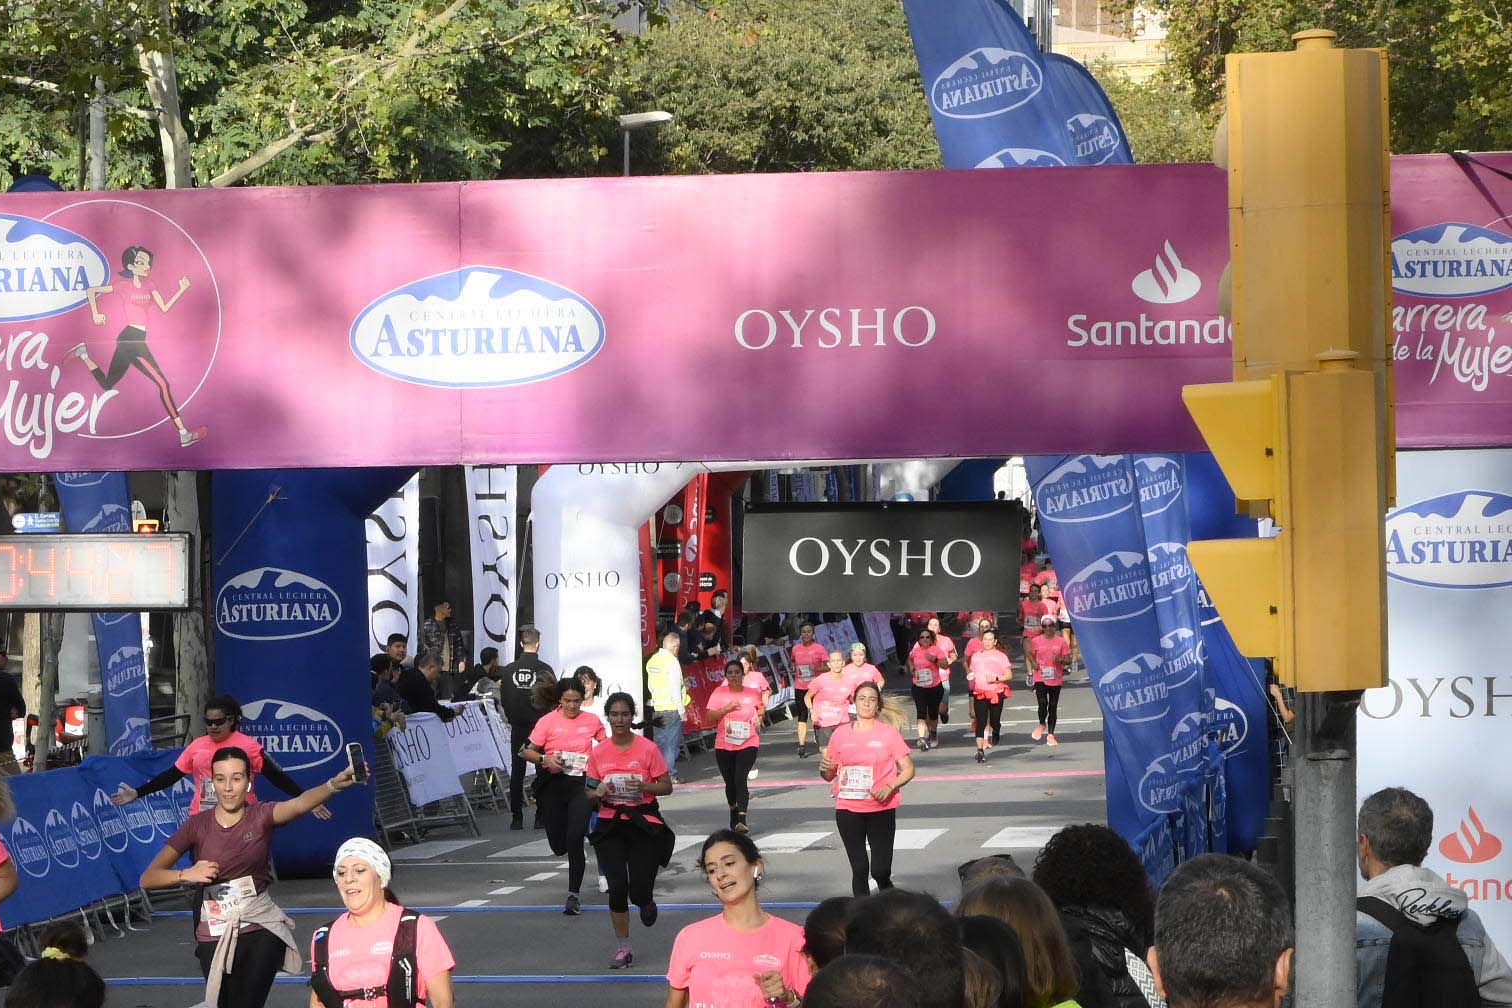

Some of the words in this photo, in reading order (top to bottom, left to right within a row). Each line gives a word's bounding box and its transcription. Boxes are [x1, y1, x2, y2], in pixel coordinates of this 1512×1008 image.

[11, 250, 86, 261] LECHERA
[1392, 303, 1488, 332] arrera
[368, 313, 586, 358] ASTURIANA
[733, 305, 938, 351] OYSHO
[1415, 332, 1433, 361] la
[1429, 326, 1512, 392] Muje
[1412, 525, 1481, 536] CENTRAL
[1487, 524, 1512, 535] LEC
[787, 536, 984, 579] OYSHO
[544, 570, 621, 590] OYSHO
[232, 592, 274, 601] CENTRAL
[279, 591, 328, 600] LECHERA
[219, 596, 333, 624] ASTURIANA
[518, 673, 532, 683] BP
[239, 724, 275, 733] ENTRAL
[255, 734, 334, 754] URIANA
